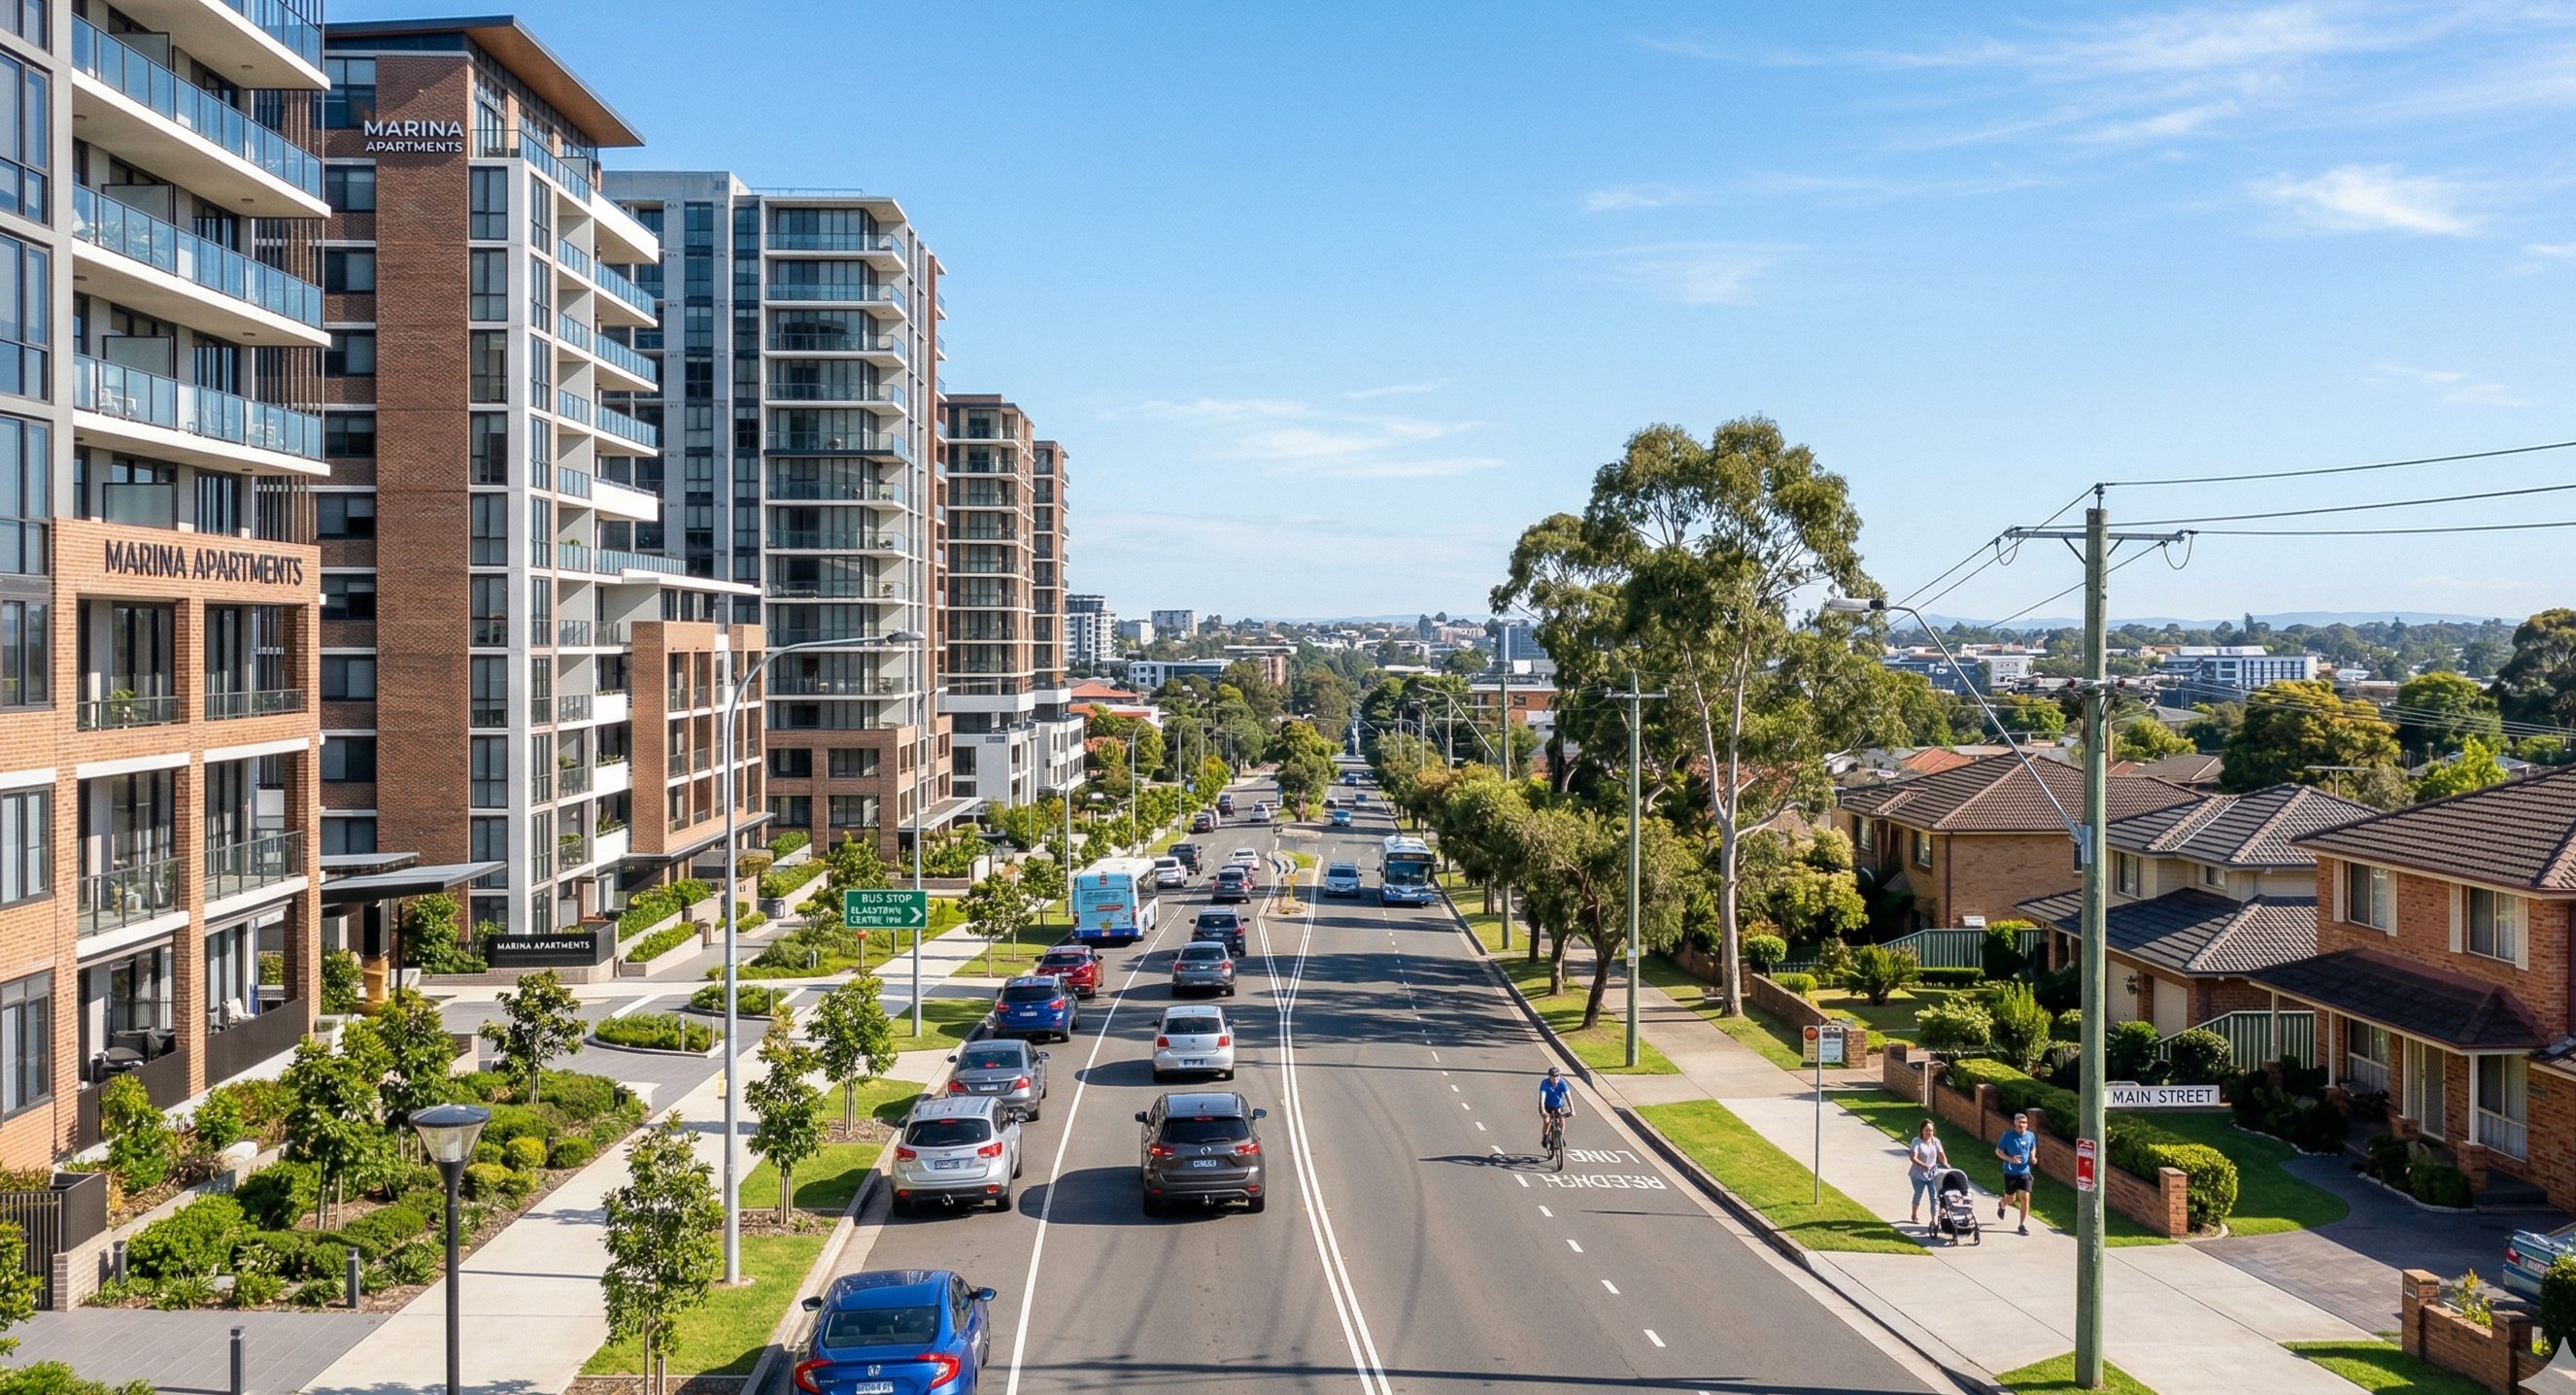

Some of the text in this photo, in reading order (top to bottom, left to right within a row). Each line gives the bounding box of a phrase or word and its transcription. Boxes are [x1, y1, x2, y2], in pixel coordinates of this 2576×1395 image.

[364, 119, 464, 137] MARINA
[365, 141, 463, 153] APARTMENTS
[105, 539, 303, 587] MARINA APARTMENTS
[862, 894, 913, 903] BUS STOP
[533, 940, 591, 950] APARTMENTS
[2113, 1089, 2214, 1104] MAIN STREET
